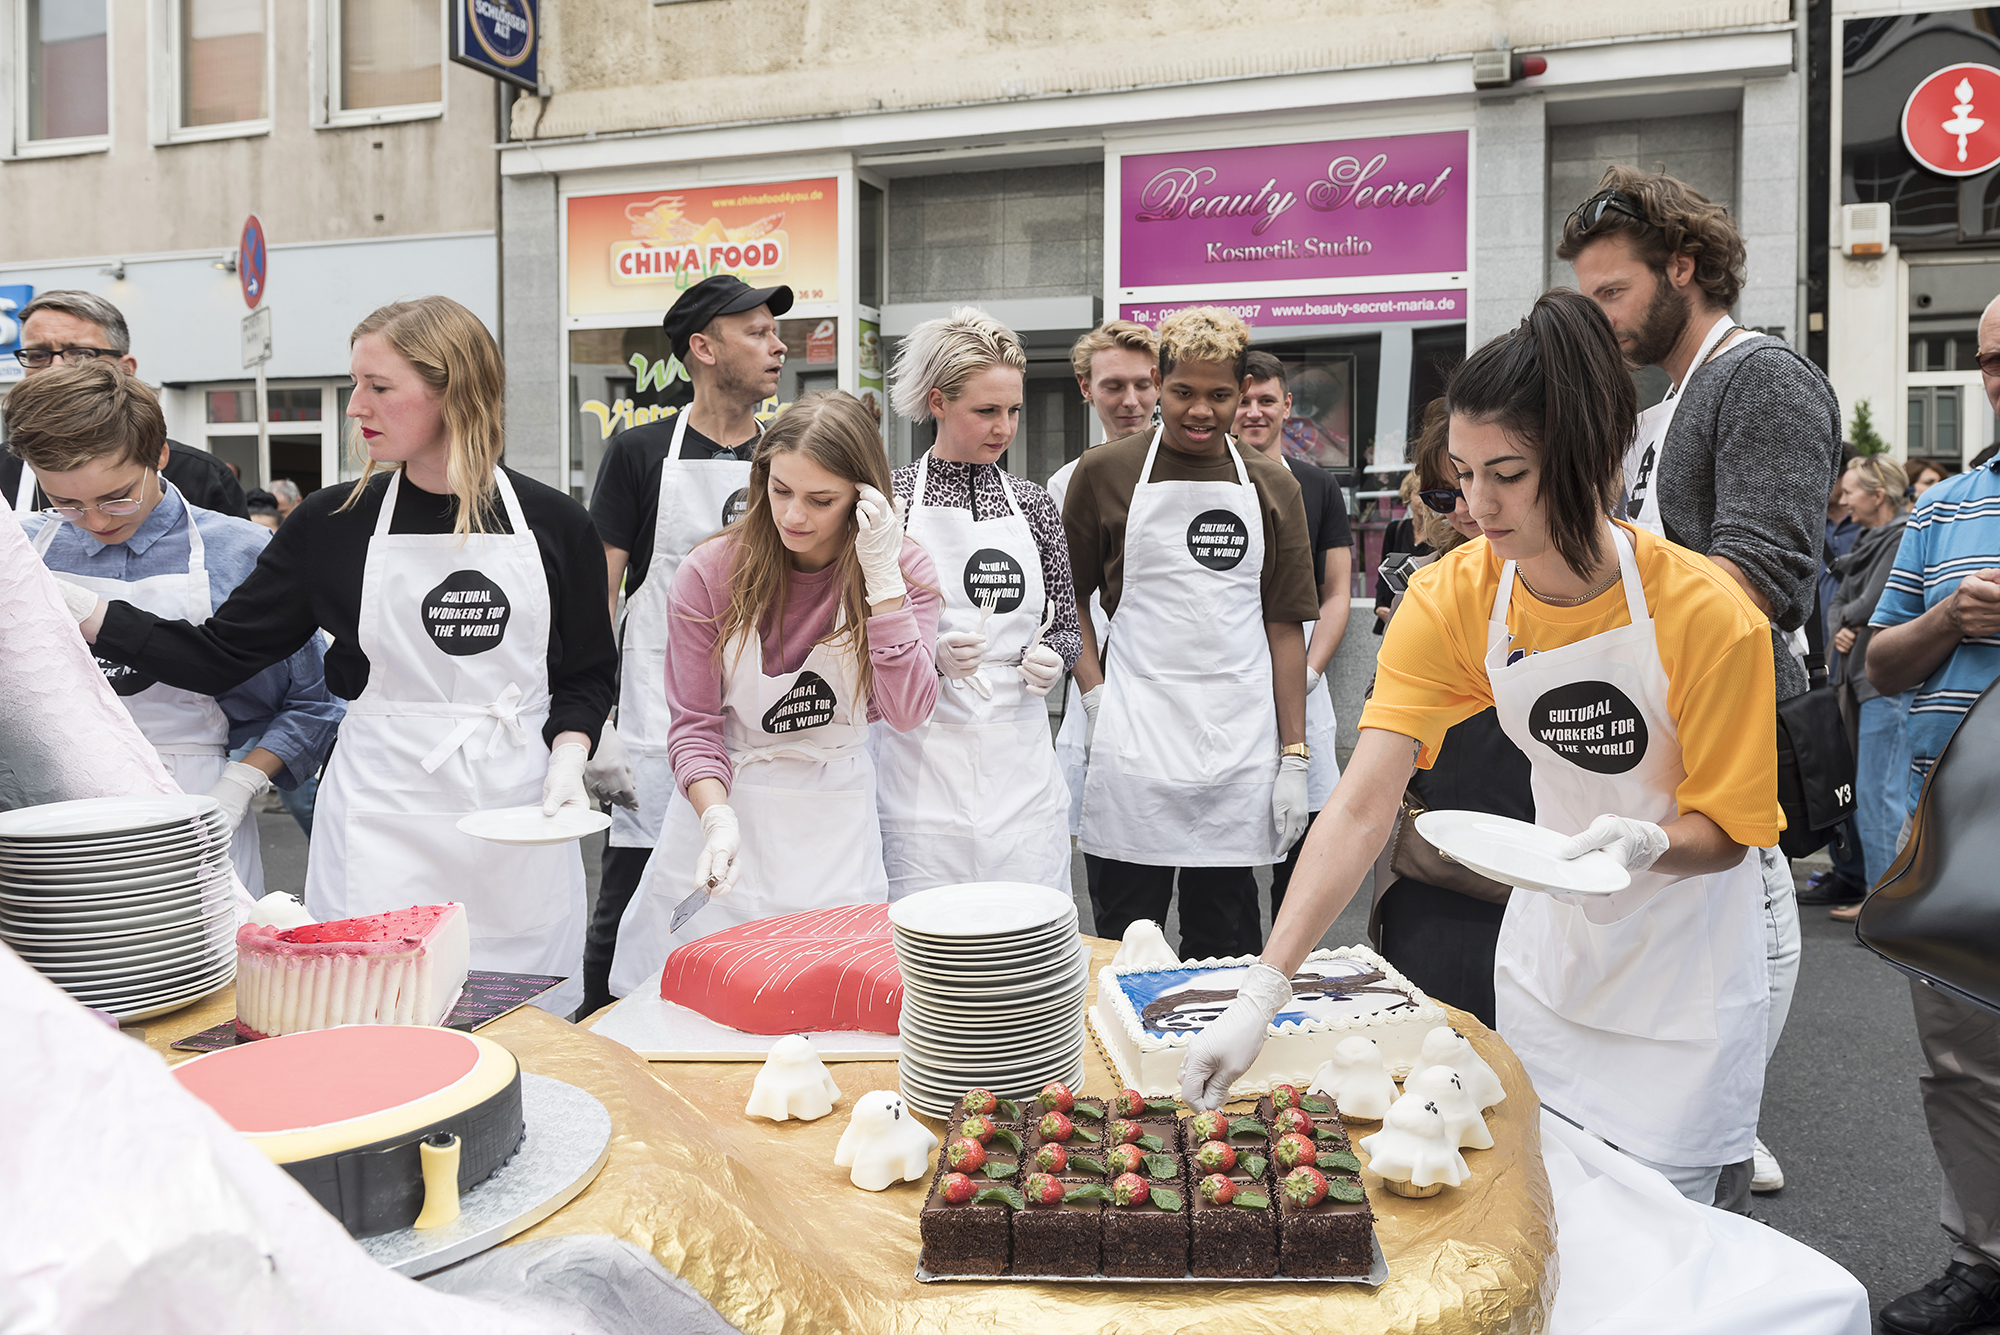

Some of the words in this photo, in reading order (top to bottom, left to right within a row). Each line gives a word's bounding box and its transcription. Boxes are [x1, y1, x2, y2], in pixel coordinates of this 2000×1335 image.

[493, 21, 511, 40] ALT
[711, 189, 823, 208] www.chinafood4you.de
[1135, 166, 1298, 236] Beauty
[1305, 153, 1453, 212] Secret
[619, 247, 701, 275] CHINA
[709, 243, 779, 270] FOOD
[1205, 239, 1300, 264] Kosmetik
[1303, 235, 1373, 259] Studio
[1131, 310, 1157, 322] Tel.:
[1271, 297, 1455, 317] www.beauty-secret-maria.de
[1199, 523, 1236, 533] CULTURAL
[1192, 535, 1229, 545] WORKERS
[1230, 536, 1245, 546] FOR
[1196, 547, 1211, 557] THE
[1213, 547, 1241, 558] WORLD
[969, 573, 1007, 584] WORKERS
[1008, 573, 1021, 584] FOR
[441, 590, 491, 603] CULTURAL
[428, 606, 484, 620] WORKERS
[486, 606, 506, 620] FOR
[434, 624, 456, 637] THE
[460, 623, 500, 637] WORLD
[814, 699, 831, 710] FOR
[1549, 699, 1612, 723] CULTURAL
[773, 719, 791, 733] THE
[795, 713, 830, 728] WORLD
[1540, 724, 1605, 742] WORKERS
[1610, 718, 1635, 737] FOR
[1556, 743, 1580, 754] THE
[1585, 740, 1635, 756] WORLD
[1834, 784, 1852, 807] Y3
